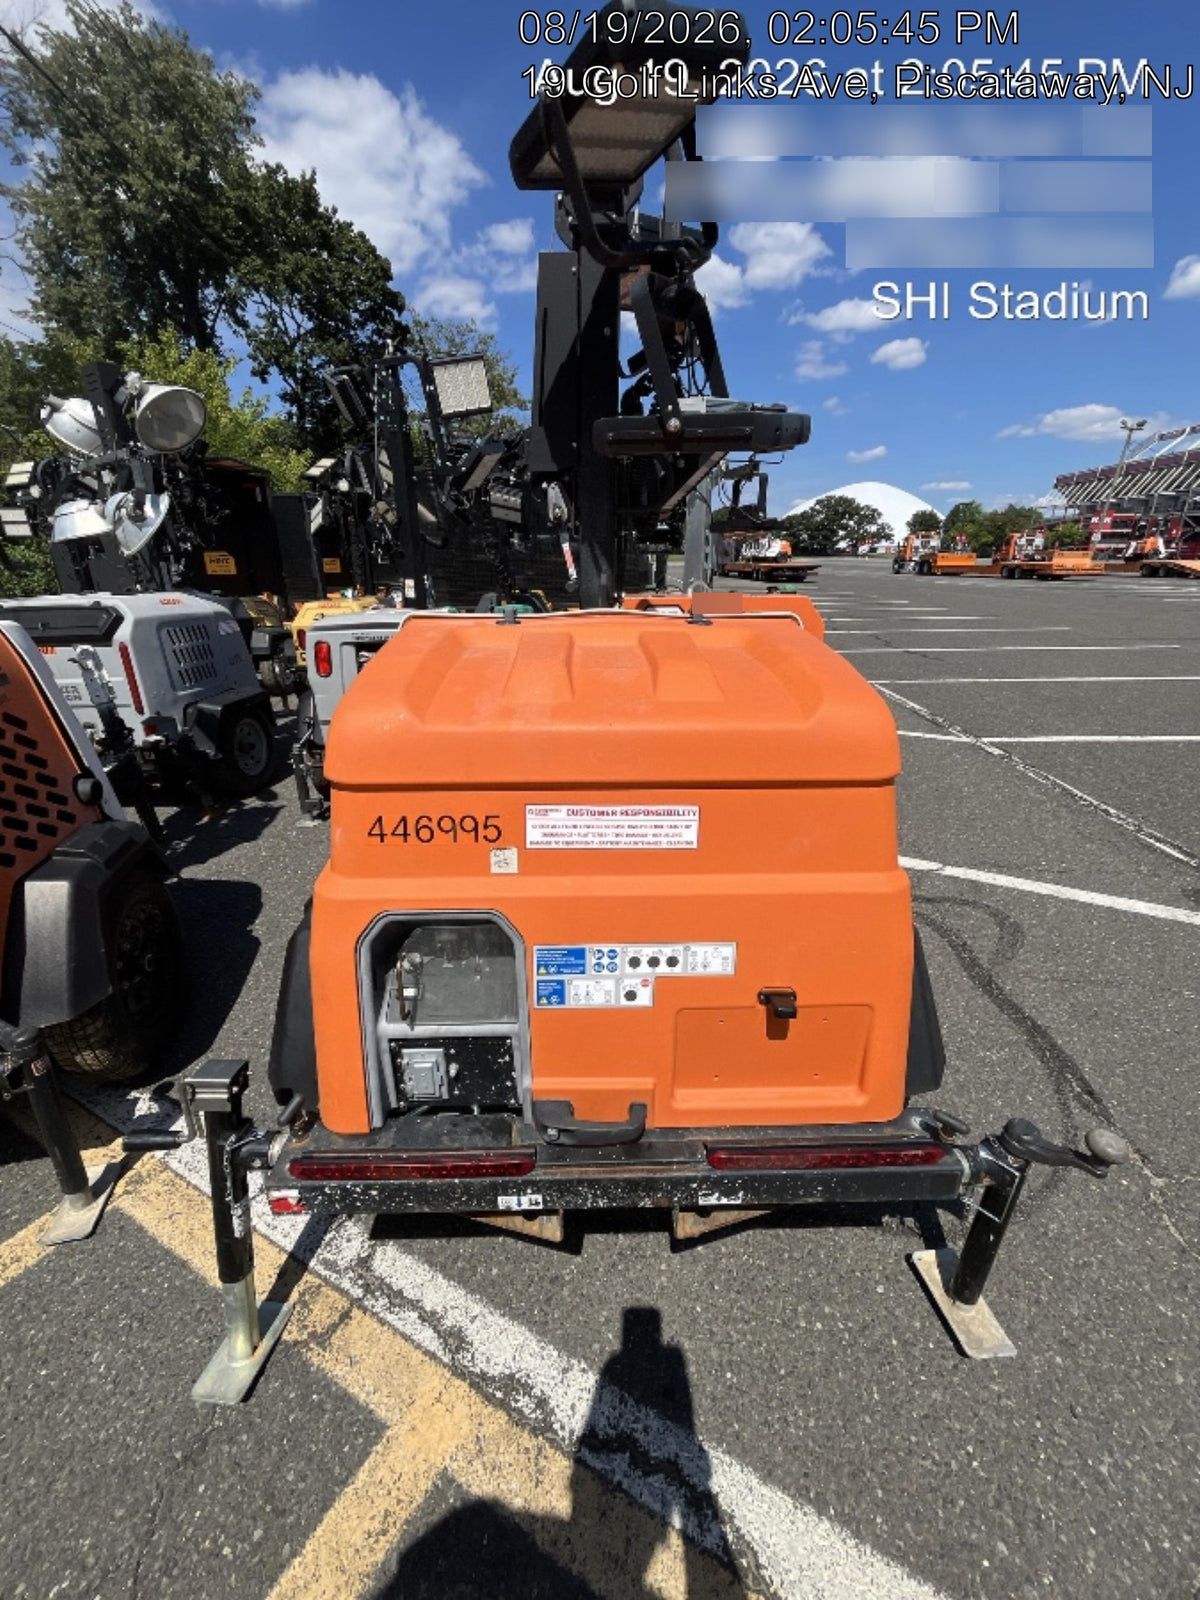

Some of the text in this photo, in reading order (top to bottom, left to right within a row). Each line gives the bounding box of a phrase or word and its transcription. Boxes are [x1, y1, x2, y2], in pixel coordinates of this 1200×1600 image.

[566, 808, 618, 817] CUSTOMER
[619, 808, 697, 817] RESPONSIBILITY
[367, 815, 502, 843] 446995
